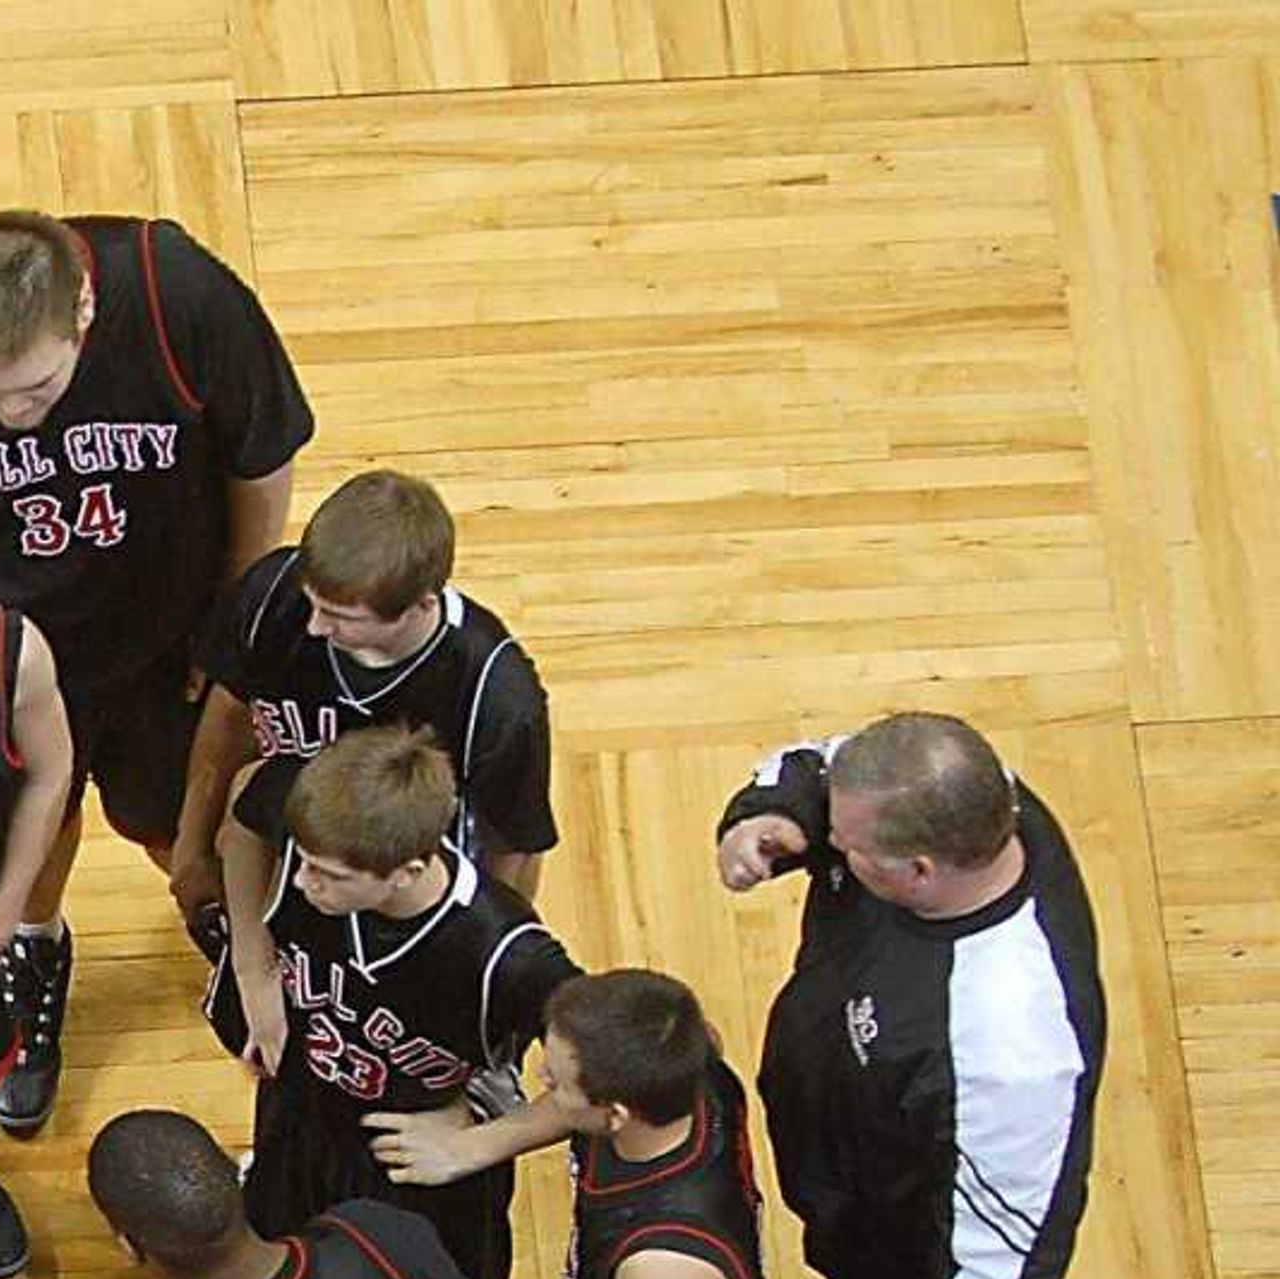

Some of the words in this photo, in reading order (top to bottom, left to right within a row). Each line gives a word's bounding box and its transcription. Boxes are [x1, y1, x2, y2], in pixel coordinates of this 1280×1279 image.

[64, 423, 177, 474] CITY
[13, 484, 127, 555] 34
[305, 1012, 388, 1100] 23
